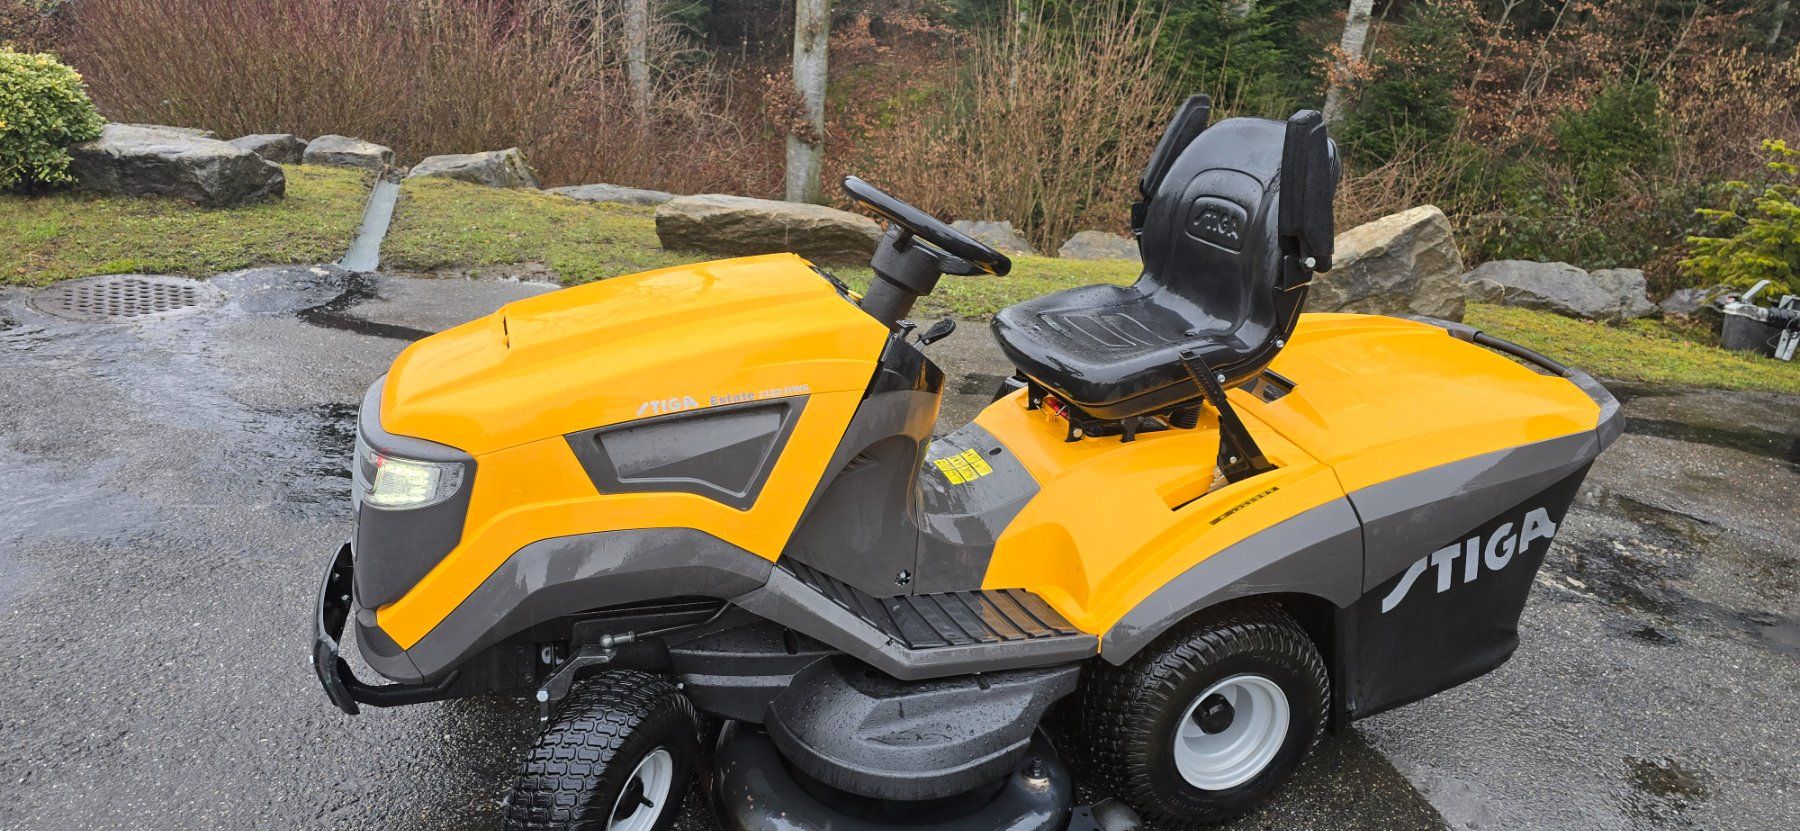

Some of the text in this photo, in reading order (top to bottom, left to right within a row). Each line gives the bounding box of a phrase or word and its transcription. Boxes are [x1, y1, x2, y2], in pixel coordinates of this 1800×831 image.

[1192, 208, 1241, 240] STIGA
[636, 396, 699, 416] STIGA
[709, 391, 755, 406] Estate
[1382, 507, 1556, 614] STIGA
